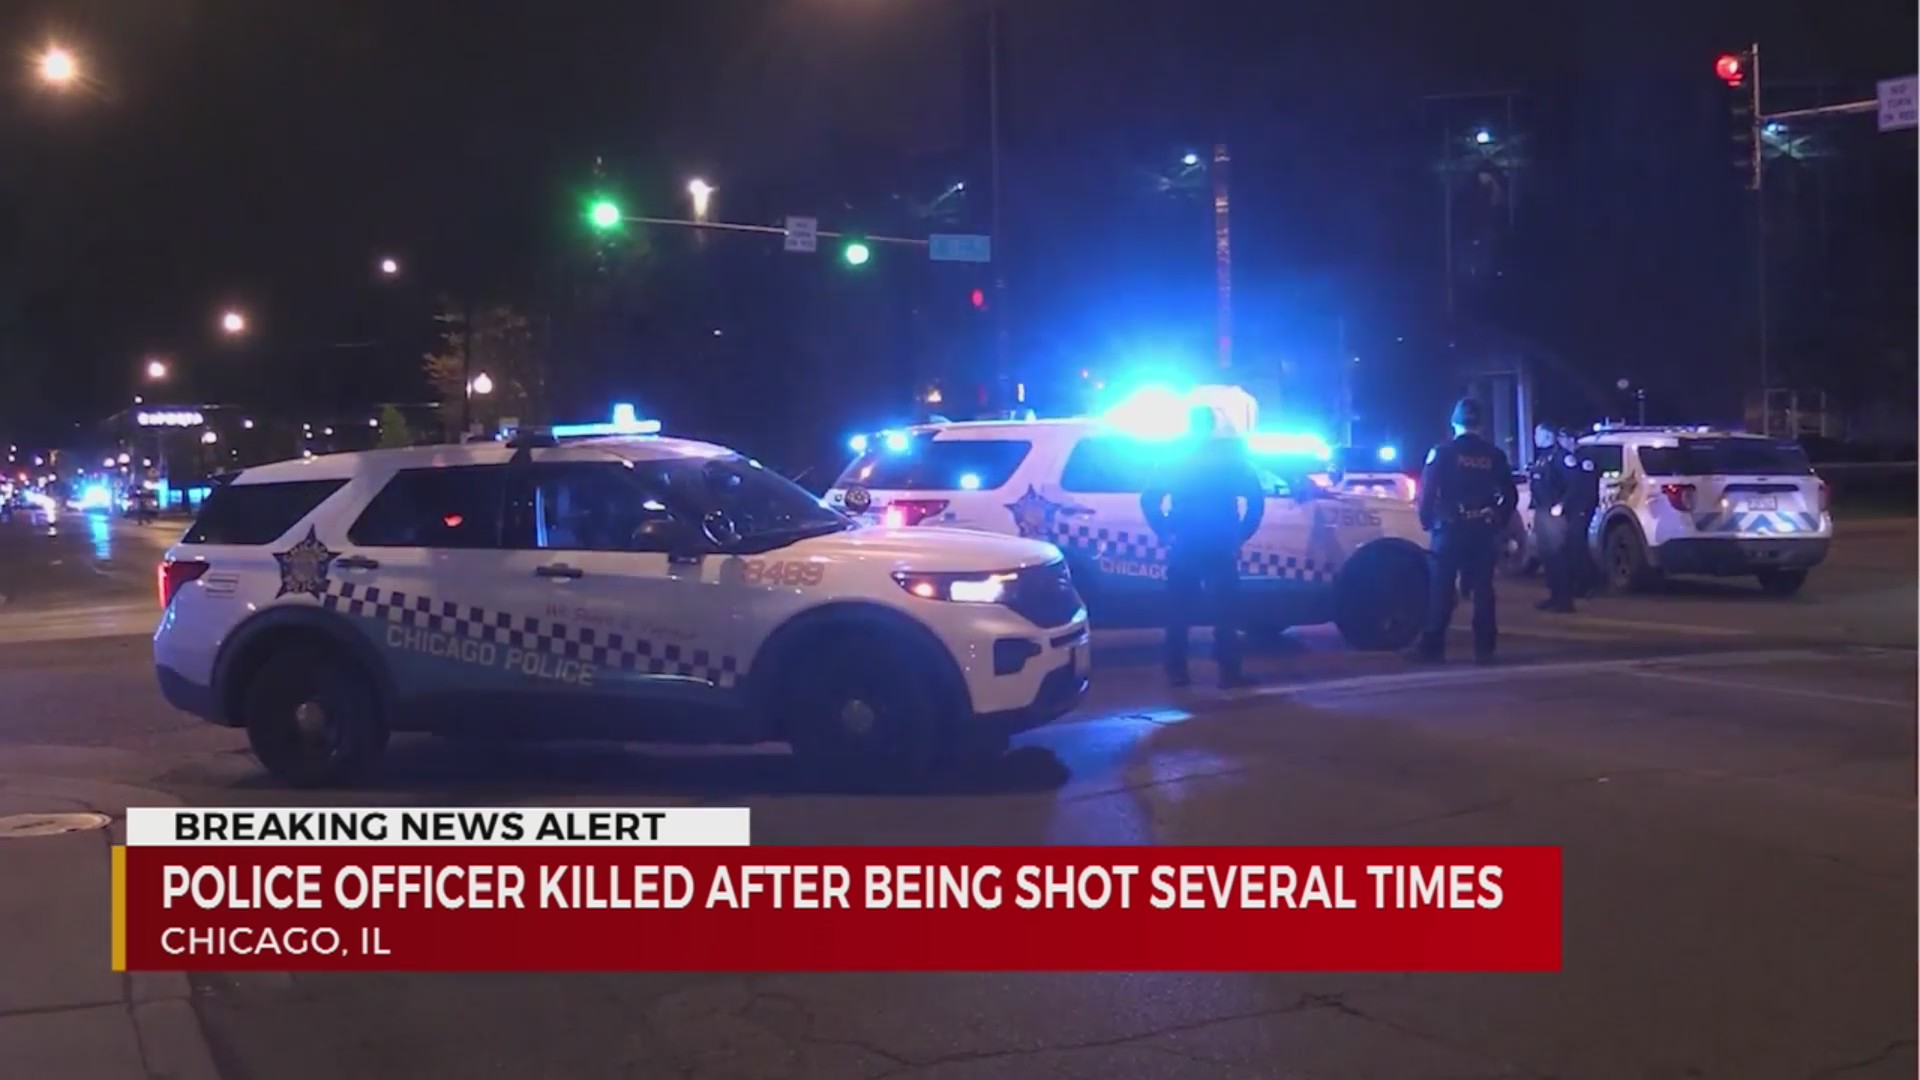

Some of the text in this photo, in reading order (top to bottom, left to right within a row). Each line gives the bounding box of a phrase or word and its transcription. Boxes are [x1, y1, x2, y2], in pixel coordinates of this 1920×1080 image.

[1457, 453, 1493, 471] POLICE
[386, 624, 598, 687] CHICAGO POLICE
